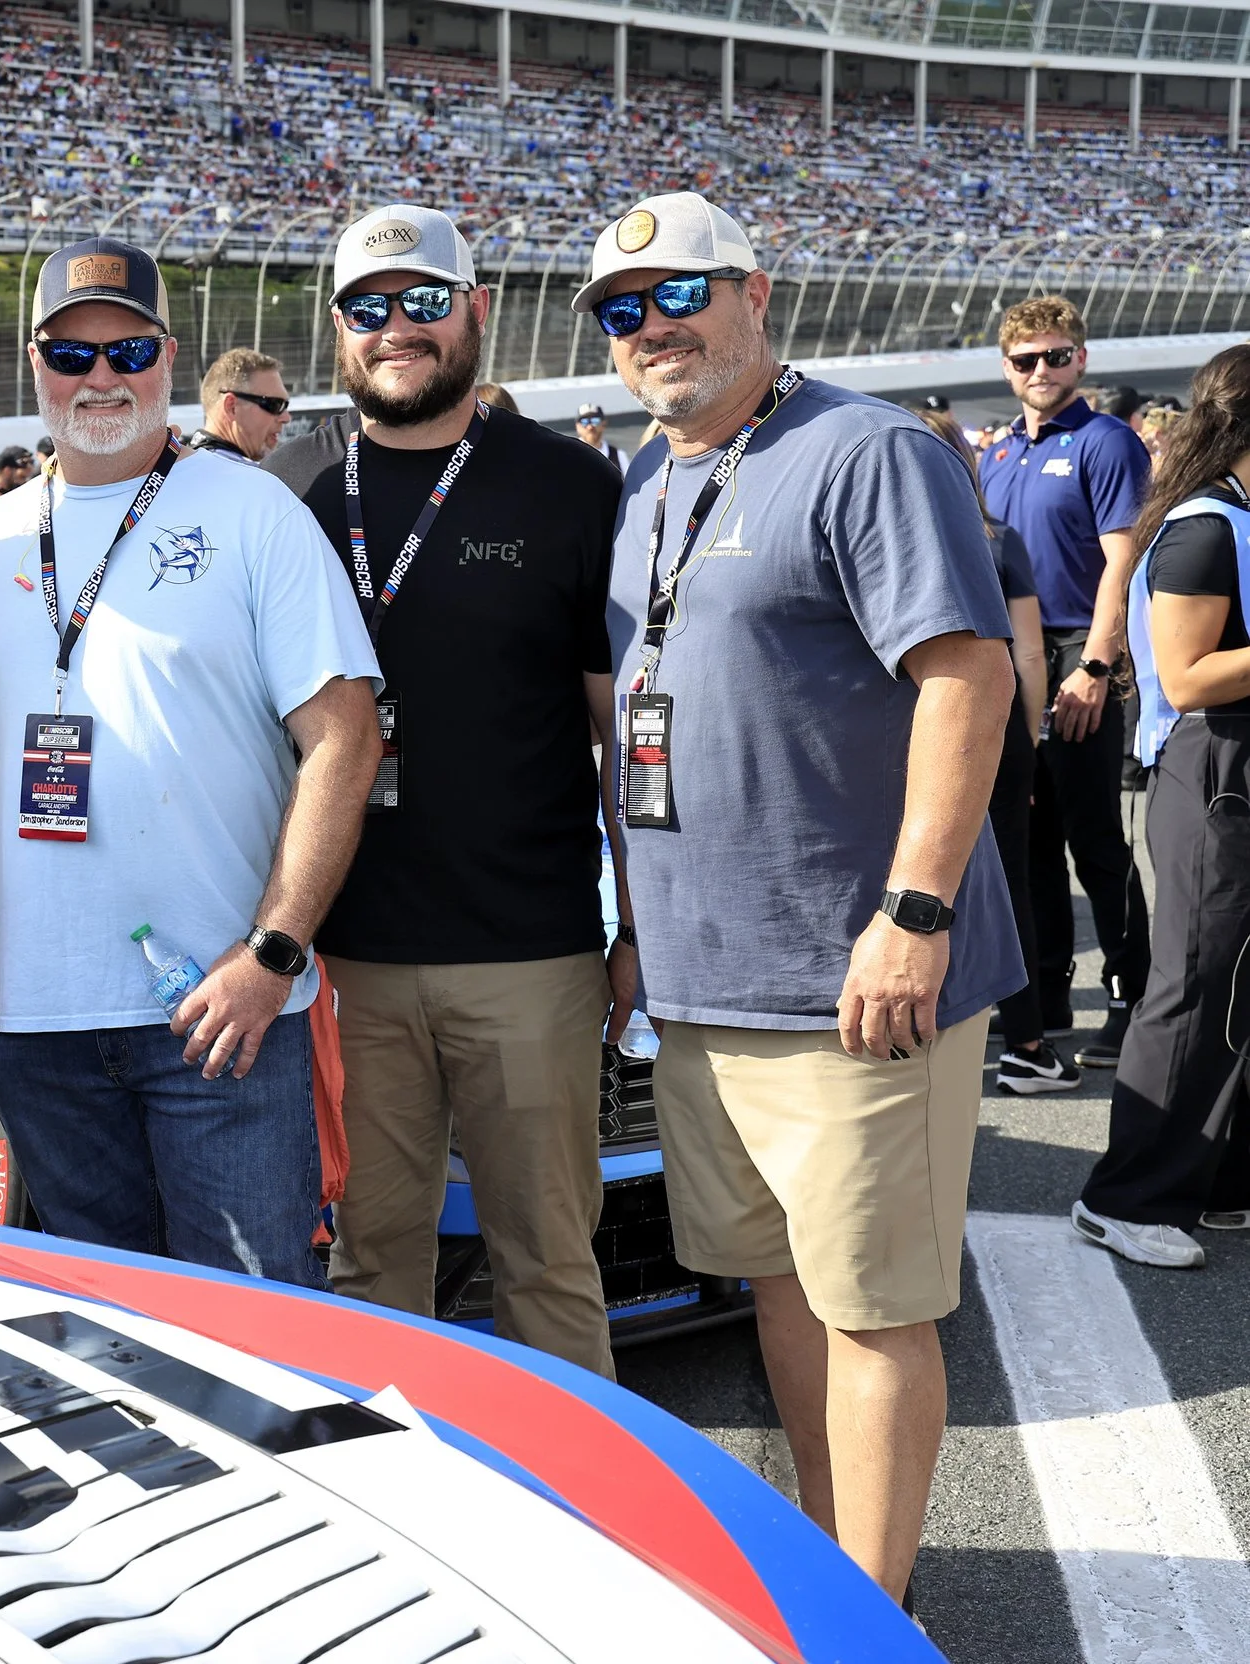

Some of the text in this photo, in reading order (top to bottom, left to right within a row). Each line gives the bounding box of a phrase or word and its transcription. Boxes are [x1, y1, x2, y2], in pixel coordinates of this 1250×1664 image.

[378, 228, 414, 243] FOXX
[75, 269, 120, 278] HARDWARE
[85, 273, 119, 281] RENTAL
[345, 446, 360, 496] NASCAR
[437, 439, 474, 491] NASCAR
[711, 430, 753, 487] NASCAR
[132, 471, 166, 518] NASCAR
[387, 533, 422, 590] NASCAR
[464, 541, 518, 562] NFG
[731, 548, 753, 557] vines
[77, 557, 108, 612] NASCAR
[352, 545, 375, 599] NASCAR
[43, 577, 59, 626] NASCAR
[51, 727, 74, 735] NASCAR
[32, 783, 78, 795] CHARLOTTE
[50, 794, 78, 802] SPEEDWAY
[618, 767, 626, 805] CHARLOTTE
[21, 814, 86, 827] Christopher Sanderson
